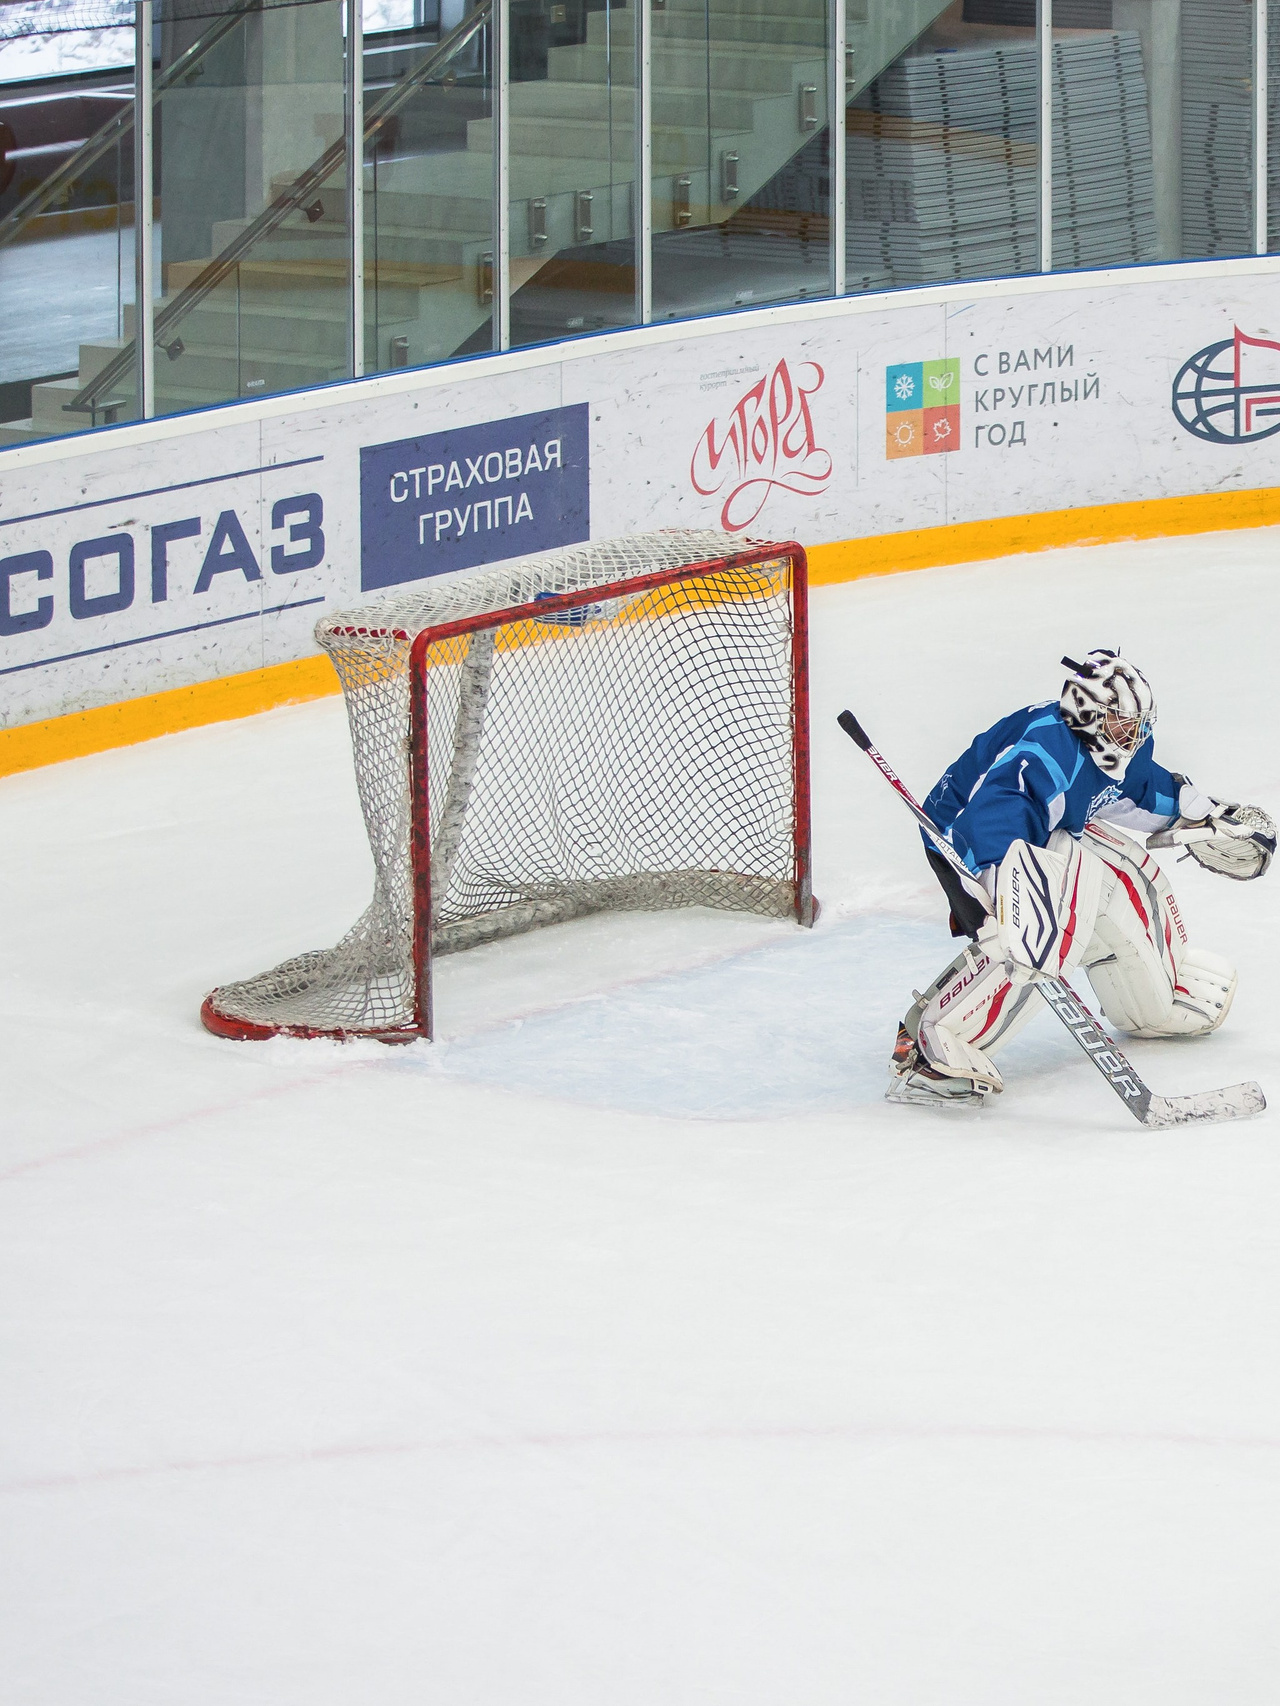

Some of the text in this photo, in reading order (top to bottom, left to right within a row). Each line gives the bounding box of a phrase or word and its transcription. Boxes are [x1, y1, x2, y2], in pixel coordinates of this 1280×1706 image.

[975, 344, 1074, 377] С ВАМИ
[975, 377, 1100, 412] КРУГЛЫЙ
[975, 420, 1028, 448] ГОД
[389, 438, 563, 504] СТРАХОВАЯ
[417, 492, 534, 546] ГРУППА
[0, 492, 326, 637] СОГАЗ
[1042, 977, 1143, 1101] BAUER
